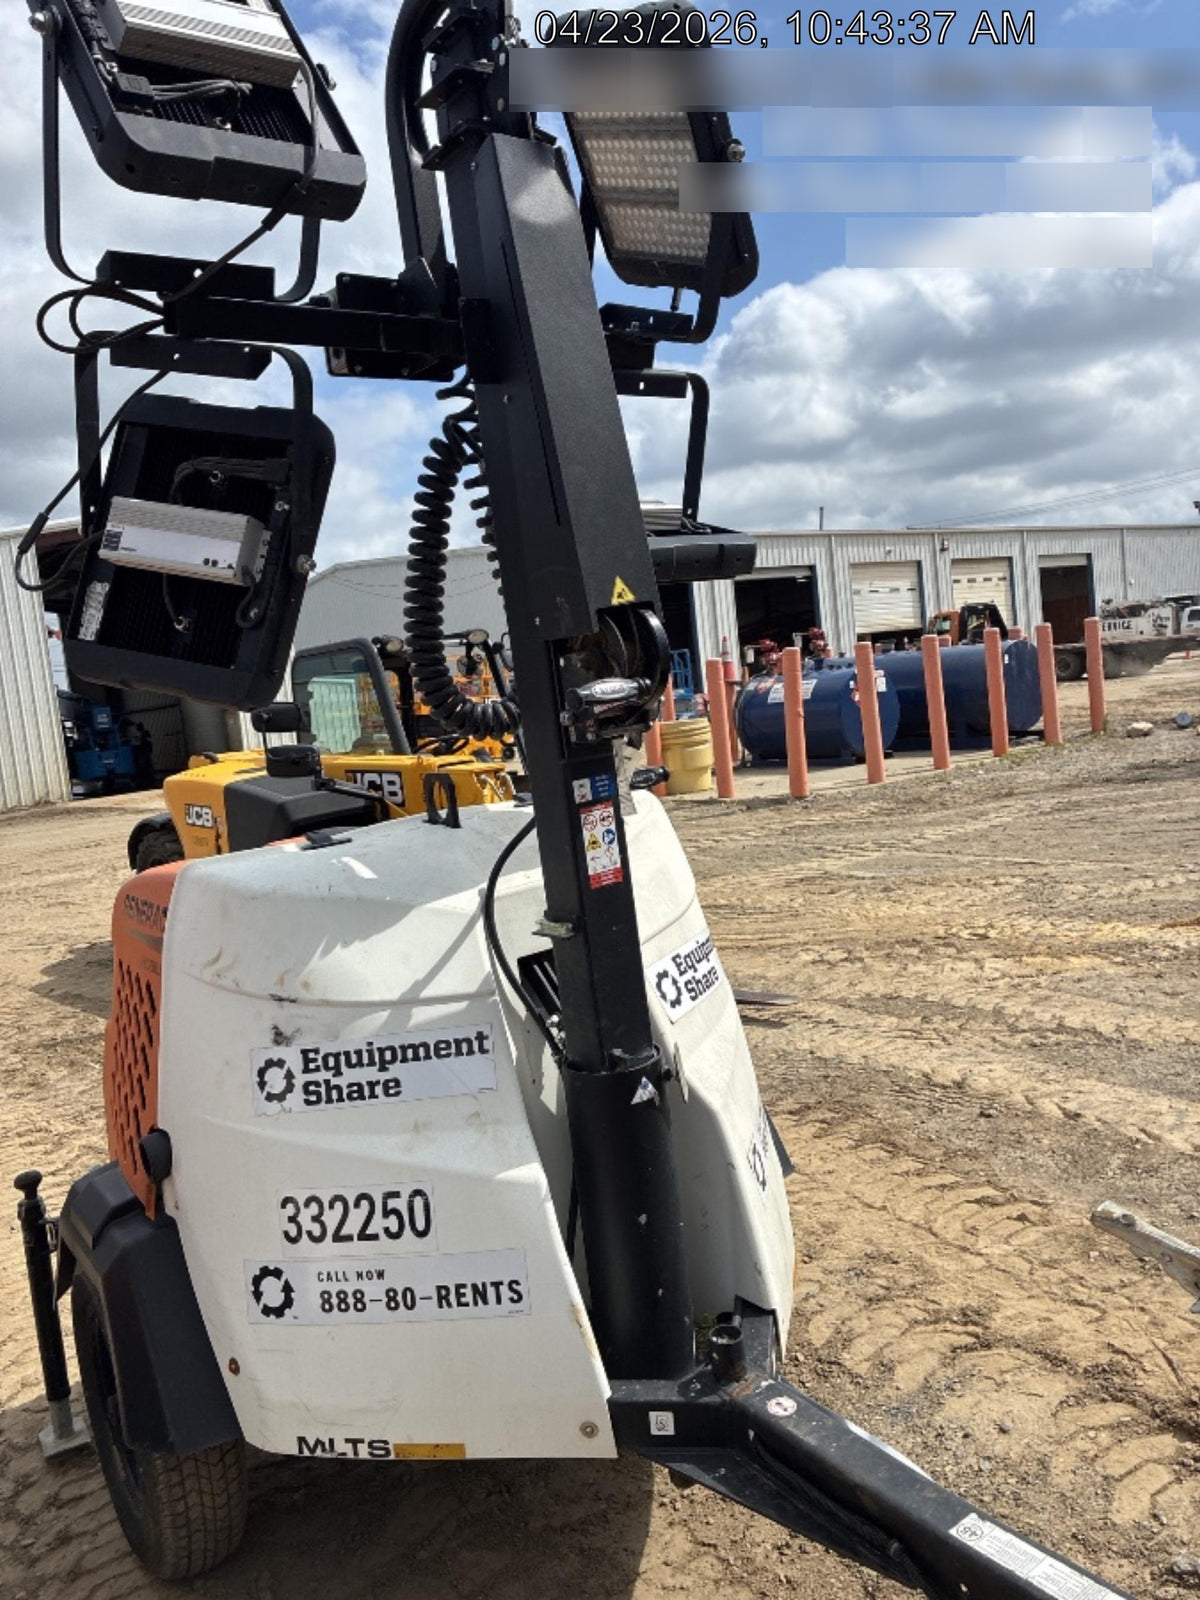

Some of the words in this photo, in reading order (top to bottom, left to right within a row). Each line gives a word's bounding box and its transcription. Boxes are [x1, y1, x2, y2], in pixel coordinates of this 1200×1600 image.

[1102, 620, 1132, 632] ERVICE
[185, 806, 213, 827] JCB
[671, 937, 713, 977] Equip
[684, 966, 719, 1001] Share
[300, 1031, 490, 1077] Equipment
[302, 1077, 402, 1106] Share
[280, 1188, 432, 1245] 332250
[317, 1271, 350, 1282] CALL
[356, 1269, 386, 1281] NOW
[319, 1279, 524, 1313] 888-80-RENTS
[297, 1436, 392, 1458] MLTS
